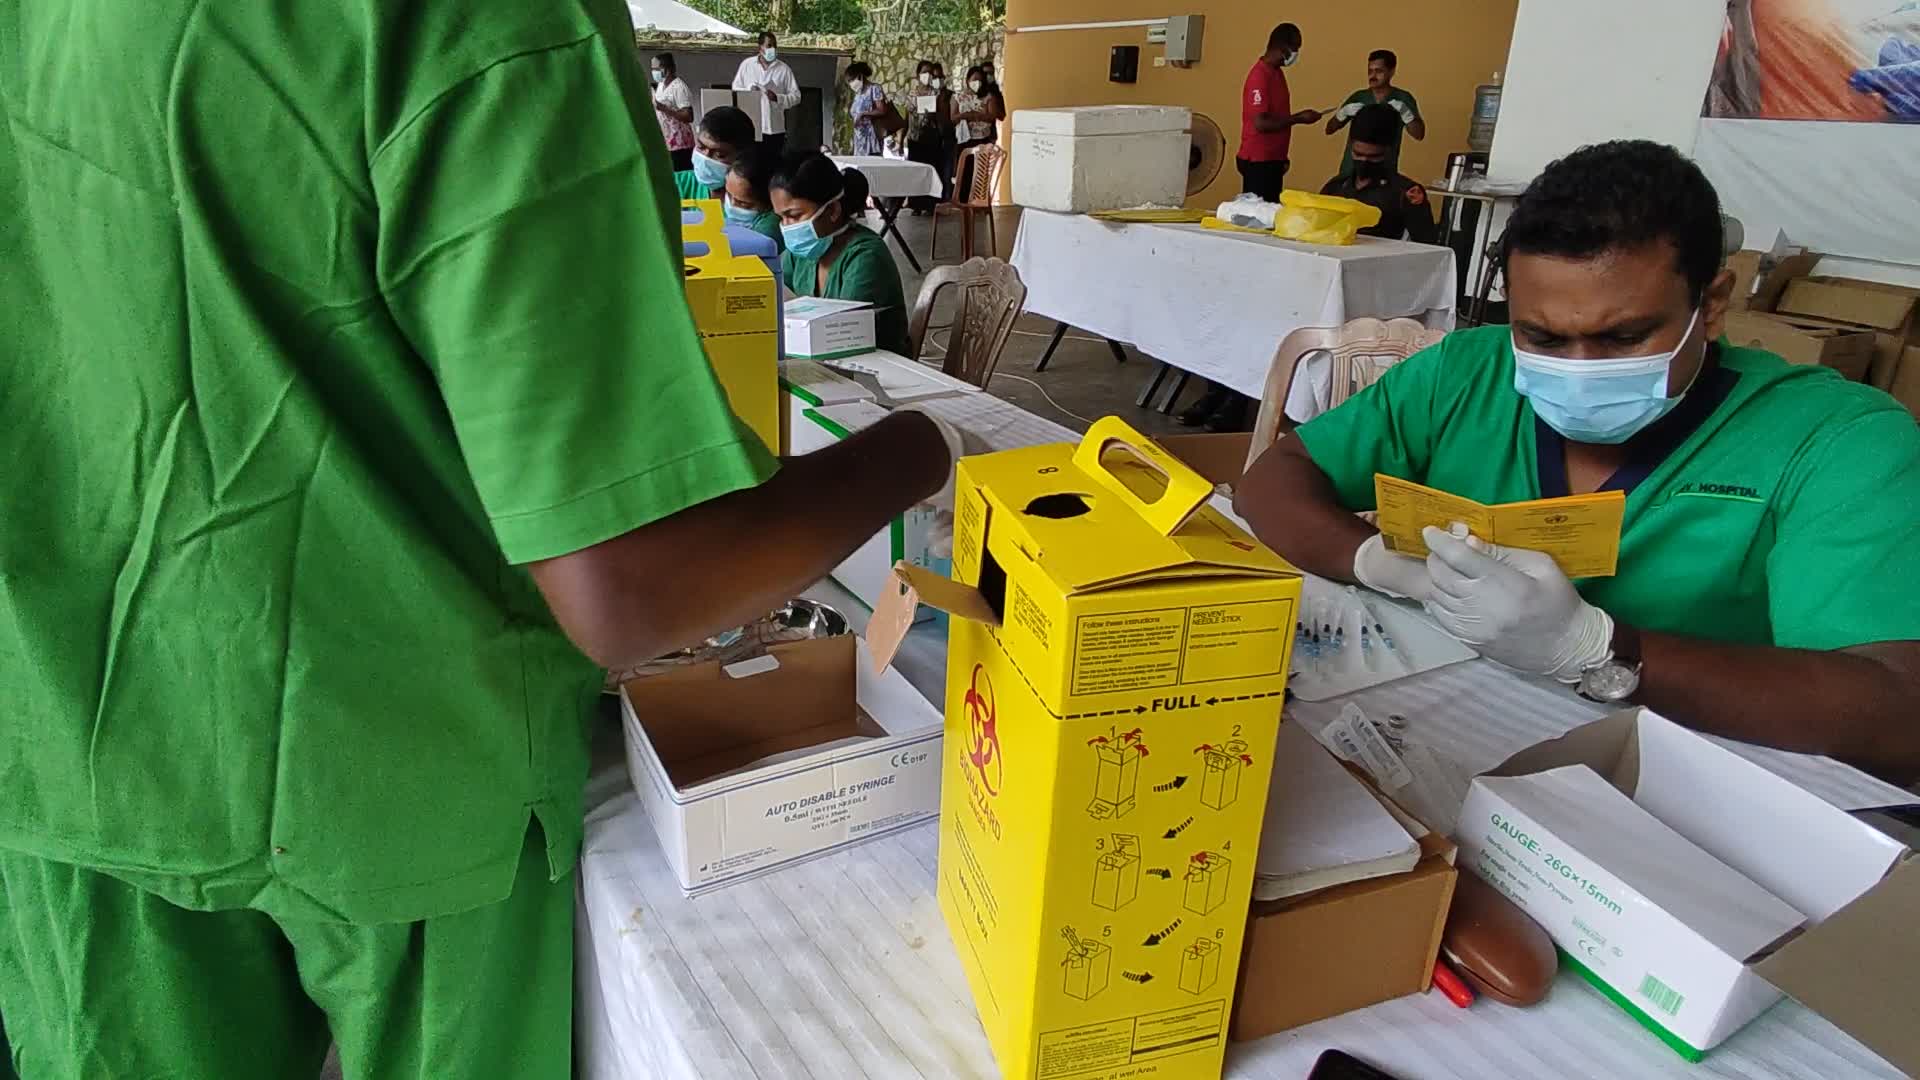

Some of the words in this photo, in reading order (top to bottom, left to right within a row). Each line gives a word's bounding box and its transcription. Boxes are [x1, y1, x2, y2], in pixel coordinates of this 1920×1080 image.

[1699, 484, 1757, 497] HOSPITAL
[1192, 617, 1220, 625] NEEDLE
[1220, 615, 1242, 623] STICK
[1193, 610, 1226, 619] PREVENT
[1152, 695, 1201, 713] FULL
[1109, 725, 1116, 738] 1
[1231, 724, 1242, 737] 2
[765, 801, 798, 817] AUTO
[799, 787, 847, 808] DISABLE
[848, 774, 896, 795] SYRINGE
[959, 747, 1002, 841] BIOHAZARD
[784, 810, 809, 822] 0.5ml
[1491, 813, 1542, 857] GAUGE:
[1095, 838, 1105, 850] 3
[1222, 840, 1232, 850] 4
[1102, 925, 1112, 937] 5
[1215, 928, 1224, 939] 6
